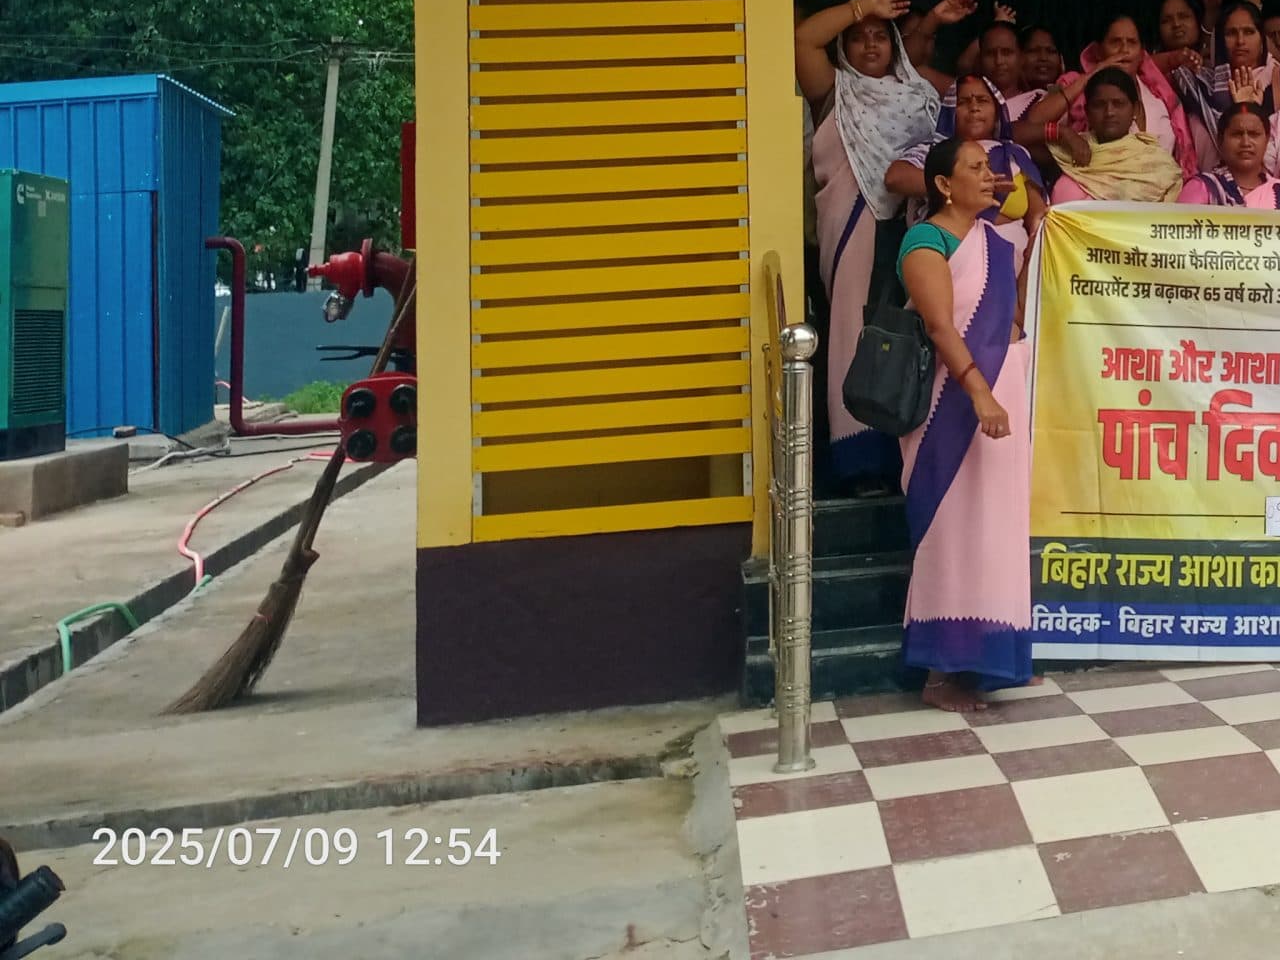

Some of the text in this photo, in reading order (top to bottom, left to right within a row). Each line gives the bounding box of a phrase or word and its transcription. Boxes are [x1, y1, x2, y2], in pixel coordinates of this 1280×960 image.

[1150, 218, 1204, 240] आशाओं
[1205, 219, 1221, 239] के
[1222, 224, 1251, 241] साथ
[1253, 224, 1274, 247] हुए
[1086, 247, 1121, 265] आशा
[1123, 246, 1148, 268] और
[1150, 252, 1187, 270] आशा
[1189, 249, 1260, 271] फैसिलिटेटर
[1262, 251, 1280, 272] को
[1070, 274, 1130, 298] रिटायरमेंट
[1132, 282, 1152, 299] उम्र
[1154, 283, 1201, 304] बढ़ाकर
[1203, 287, 1221, 302] 65
[1224, 282, 1245, 304] वर्ष
[1247, 283, 1274, 304] करो
[1101, 347, 1164, 382] आशा
[1168, 339, 1216, 384] और
[1097, 389, 1196, 480] पांच
[1040, 542, 1111, 590] बिहार
[1115, 554, 1174, 586] राज्य
[1177, 554, 1245, 588] आशा
[1031, 604, 1111, 635] निवेदक-
[1180, 616, 1228, 636] राज्य
